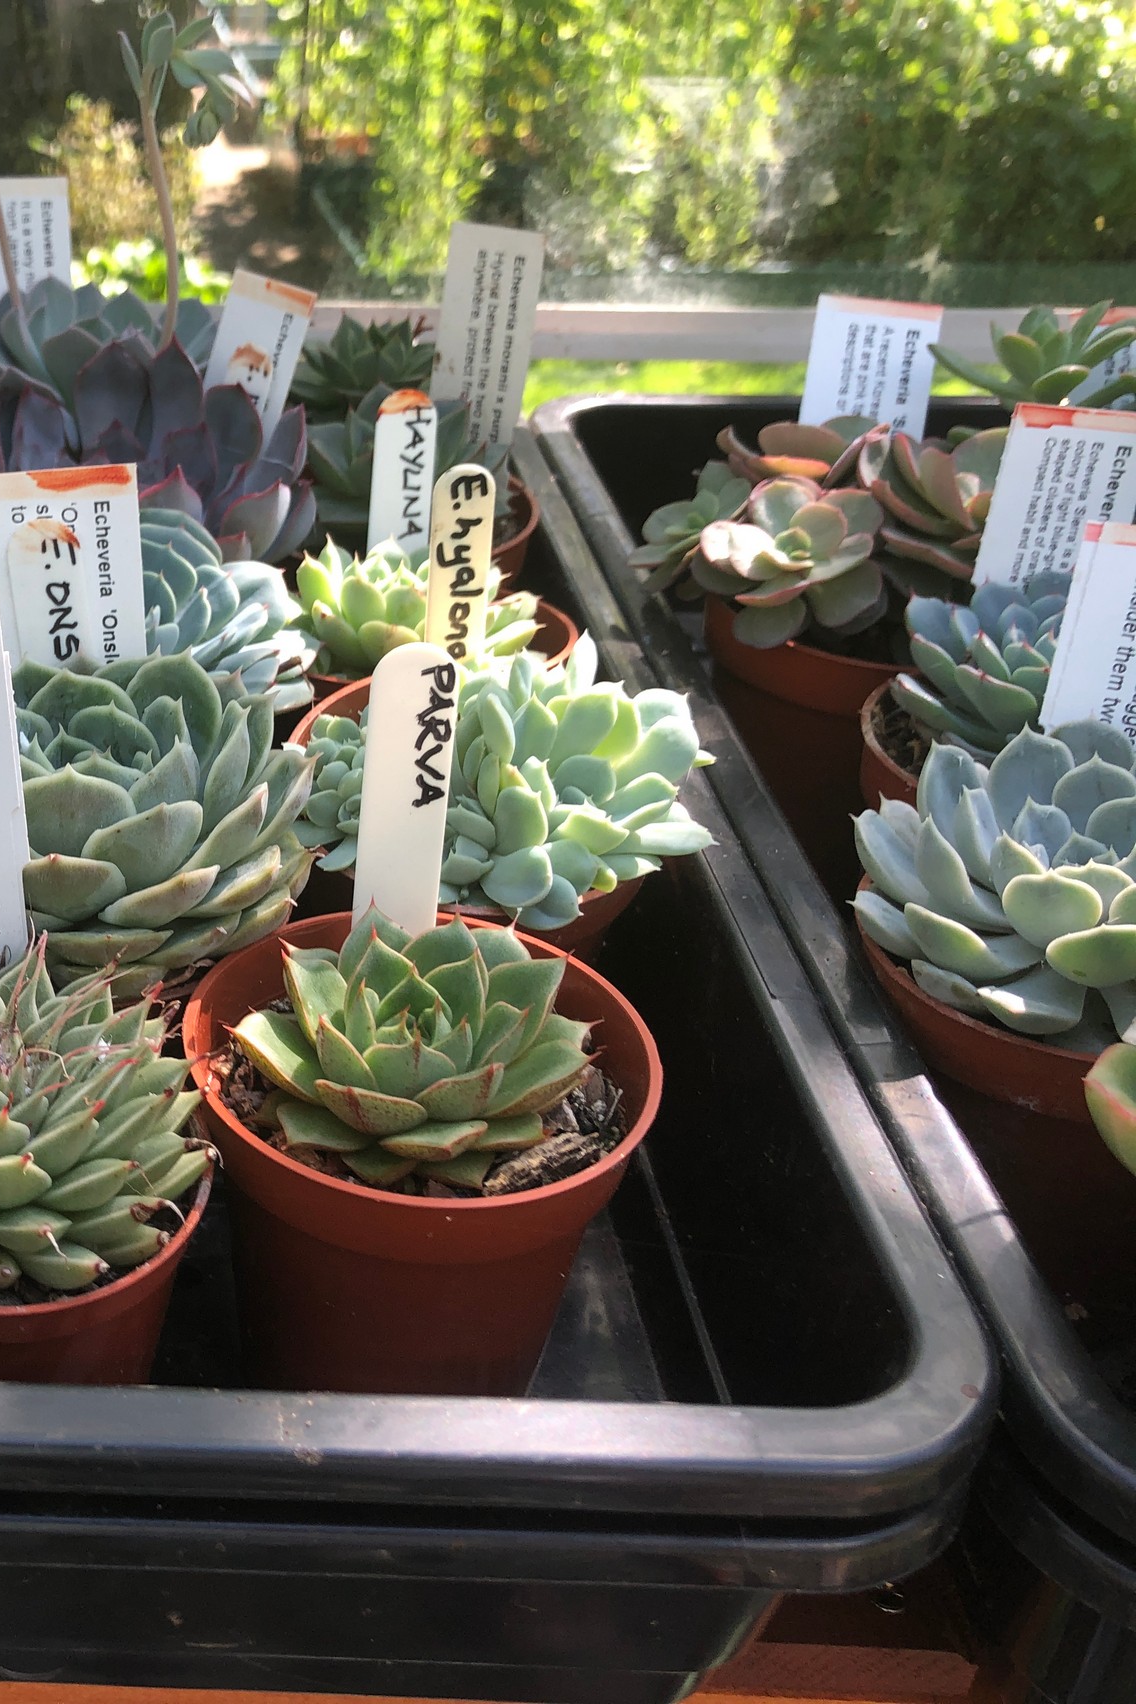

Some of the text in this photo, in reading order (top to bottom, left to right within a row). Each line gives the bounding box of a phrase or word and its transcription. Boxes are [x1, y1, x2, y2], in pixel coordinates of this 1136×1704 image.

[12, 505, 26, 524] to
[94, 501, 115, 598] Echeveria
[46, 581, 79, 661] ONS
[1107, 646, 1133, 690] them
[412, 663, 455, 809] PARVA
